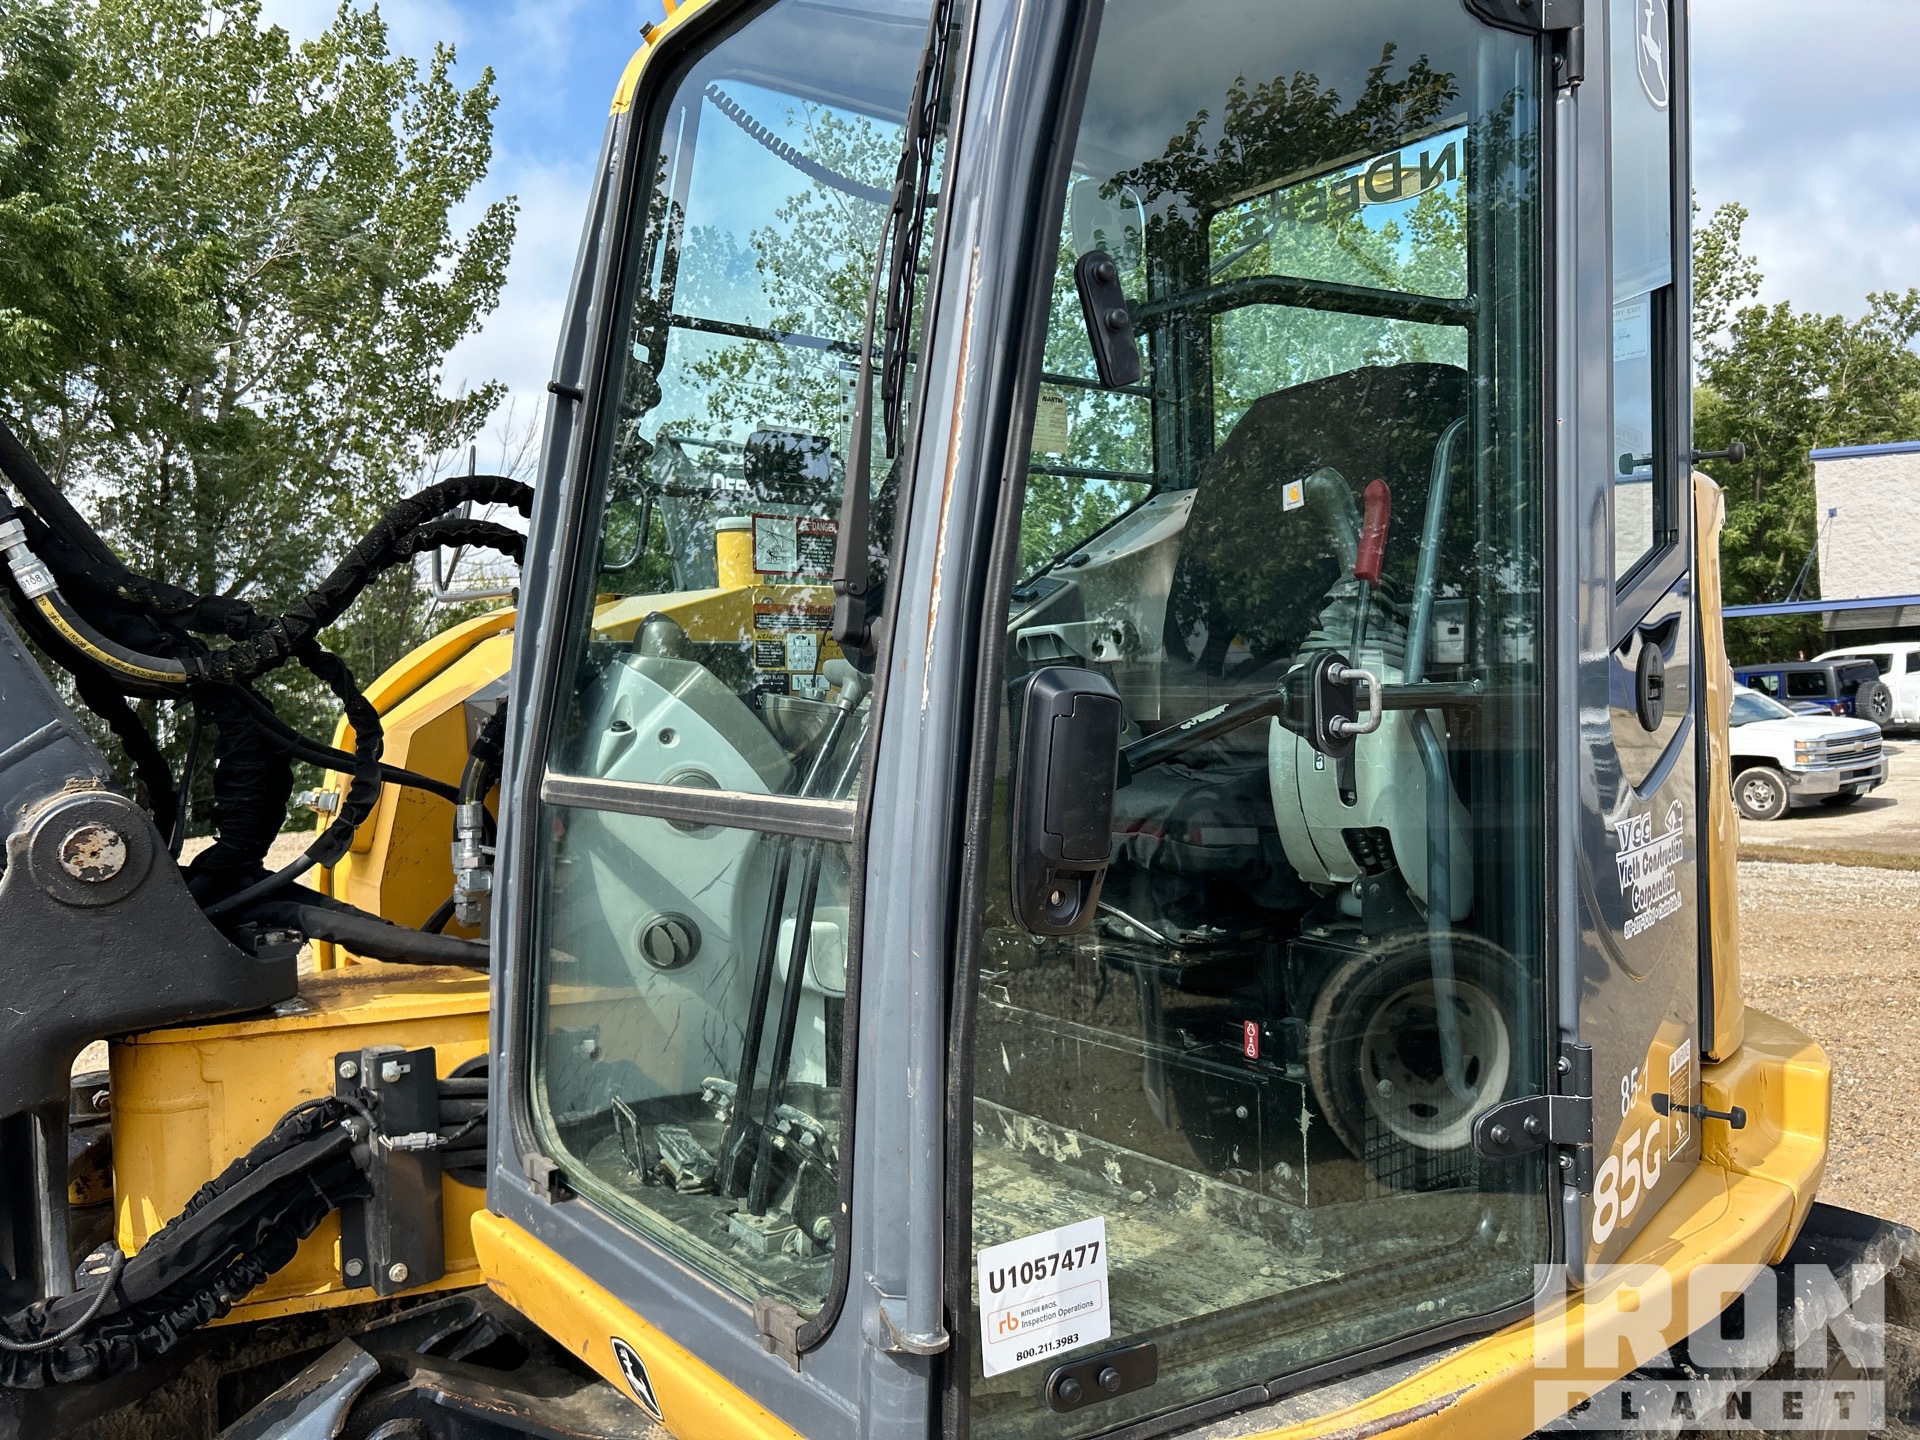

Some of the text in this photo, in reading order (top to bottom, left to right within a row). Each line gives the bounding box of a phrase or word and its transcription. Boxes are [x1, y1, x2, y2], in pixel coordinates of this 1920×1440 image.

[712, 472, 750, 490] DEE
[812, 522, 834, 532] DANGER
[1618, 838, 1683, 885] Vieth Construction
[1632, 871, 1675, 910] Corporation
[1592, 1119, 1661, 1244] 85G
[988, 1240, 1100, 1294] U1057477
[1020, 1305, 1041, 1318] RITCHIE
[1021, 1299, 1094, 1329] Inspection Operations
[1016, 1333, 1079, 1362] 800.211.3983
